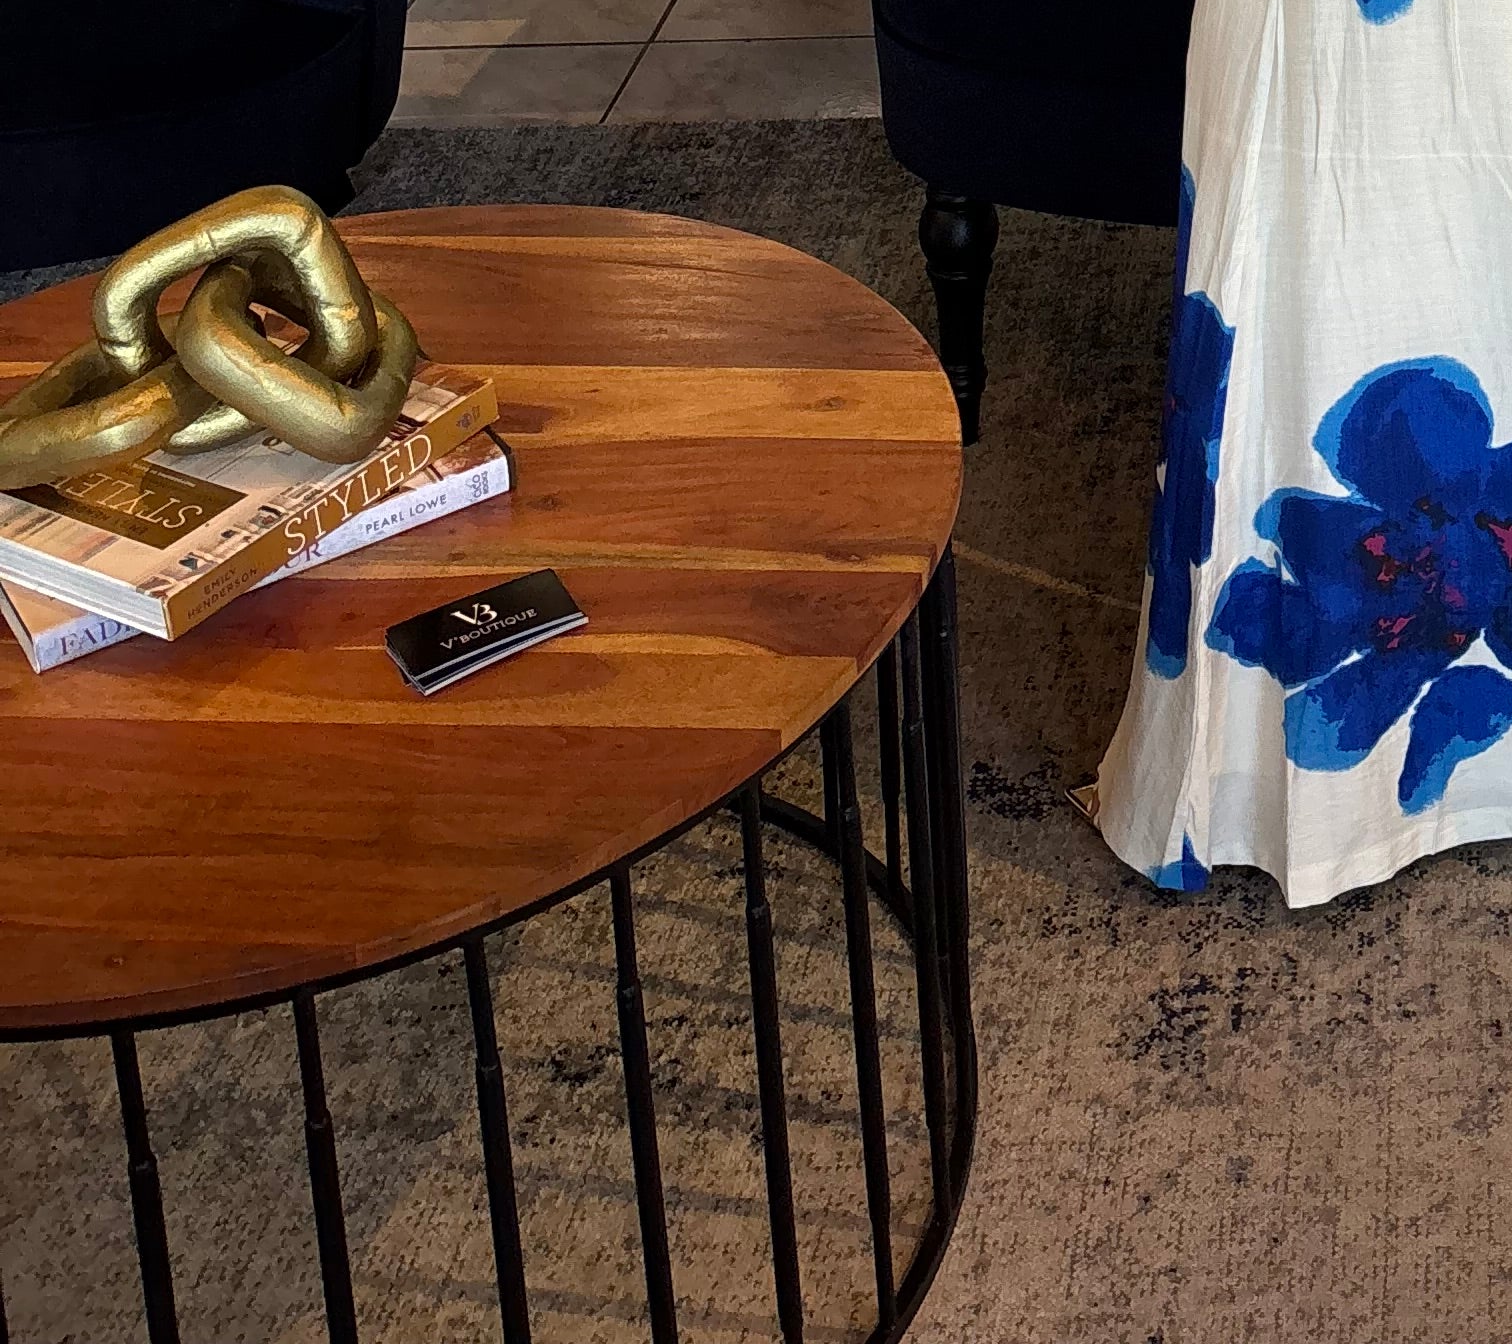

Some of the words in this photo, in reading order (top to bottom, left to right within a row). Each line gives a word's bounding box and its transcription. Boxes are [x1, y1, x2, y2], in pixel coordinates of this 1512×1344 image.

[49, 471, 203, 529] STYLE
[283, 434, 432, 556] STYLED
[365, 512, 405, 535] PEARL
[409, 493, 448, 517] LOWE
[203, 567, 236, 595] EMILY
[450, 602, 498, 626] VB
[60, 619, 131, 655] FAD
